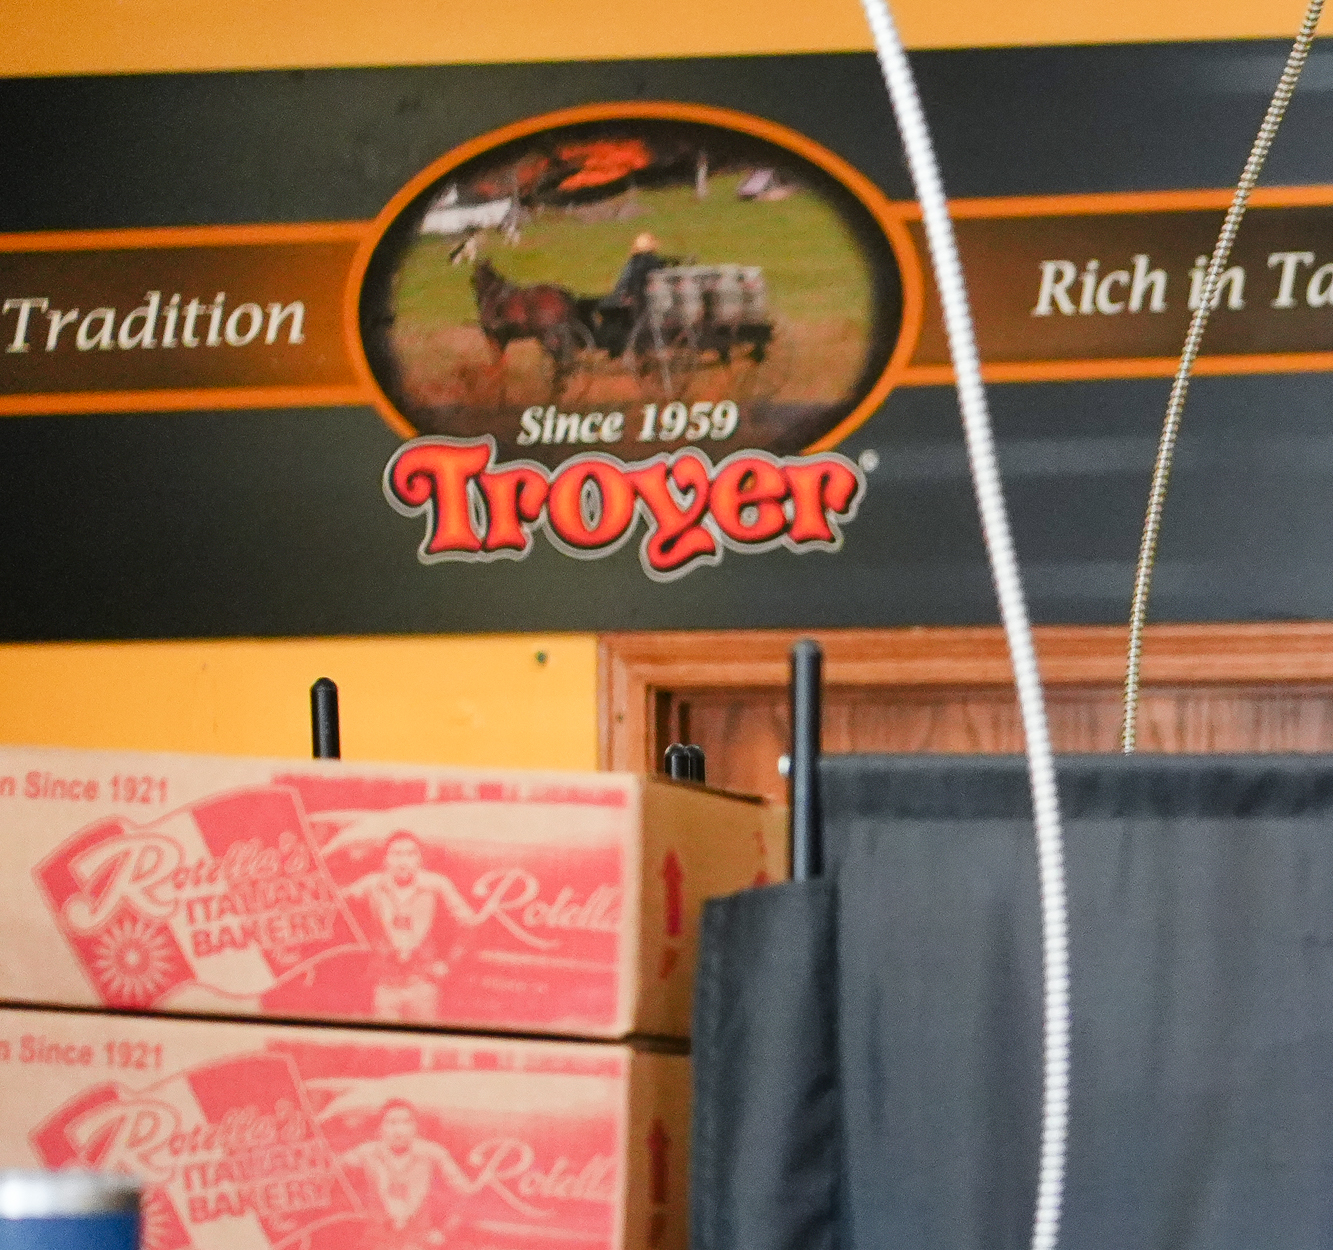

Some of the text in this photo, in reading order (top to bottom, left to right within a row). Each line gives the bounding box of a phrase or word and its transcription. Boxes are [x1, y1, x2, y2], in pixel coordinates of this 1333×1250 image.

[1031, 253, 1168, 316] Rich
[1187, 254, 1246, 311] in
[2, 289, 306, 353] Tradition
[516, 399, 739, 445] Since 1959
[388, 438, 862, 577] Troyer
[25, 771, 99, 801] Since
[111, 773, 168, 804] 1921
[190, 905, 335, 958] BAKERY
[20, 1034, 94, 1066] Since
[105, 1039, 163, 1069] 1921
